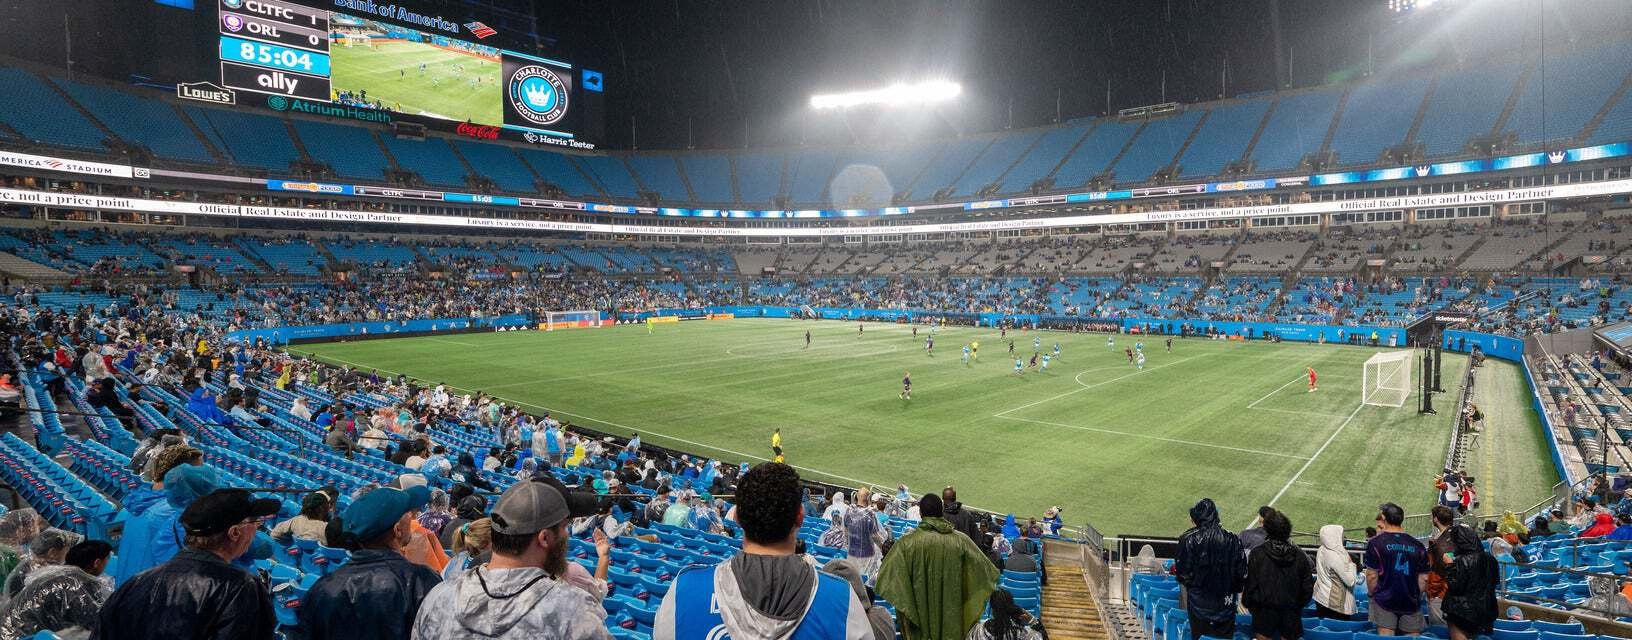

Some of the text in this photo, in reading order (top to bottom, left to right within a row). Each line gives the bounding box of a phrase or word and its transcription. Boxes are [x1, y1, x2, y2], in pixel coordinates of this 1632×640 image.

[245, 1, 317, 25] CLTFC 1
[378, 4, 396, 18] of
[396, 7, 459, 33] America
[246, 21, 319, 45] ORL 0
[240, 42, 312, 70] 85:04
[257, 71, 298, 94] ally
[515, 67, 561, 88] CHARLOTTE
[291, 99, 391, 122] Atrium Health
[515, 101, 561, 121] FOOTBALL CLUB
[539, 135, 595, 150] Harris Teeter
[66, 164, 112, 175] STADIUM
[19, 193, 40, 202] not
[56, 196, 92, 207] price
[96, 198, 134, 209] point.
[1340, 190, 1554, 209] Official Real Estate and Design Partner
[199, 204, 402, 222] Official Real Estate and Design Partner
[1394, 552, 1409, 576] 4
